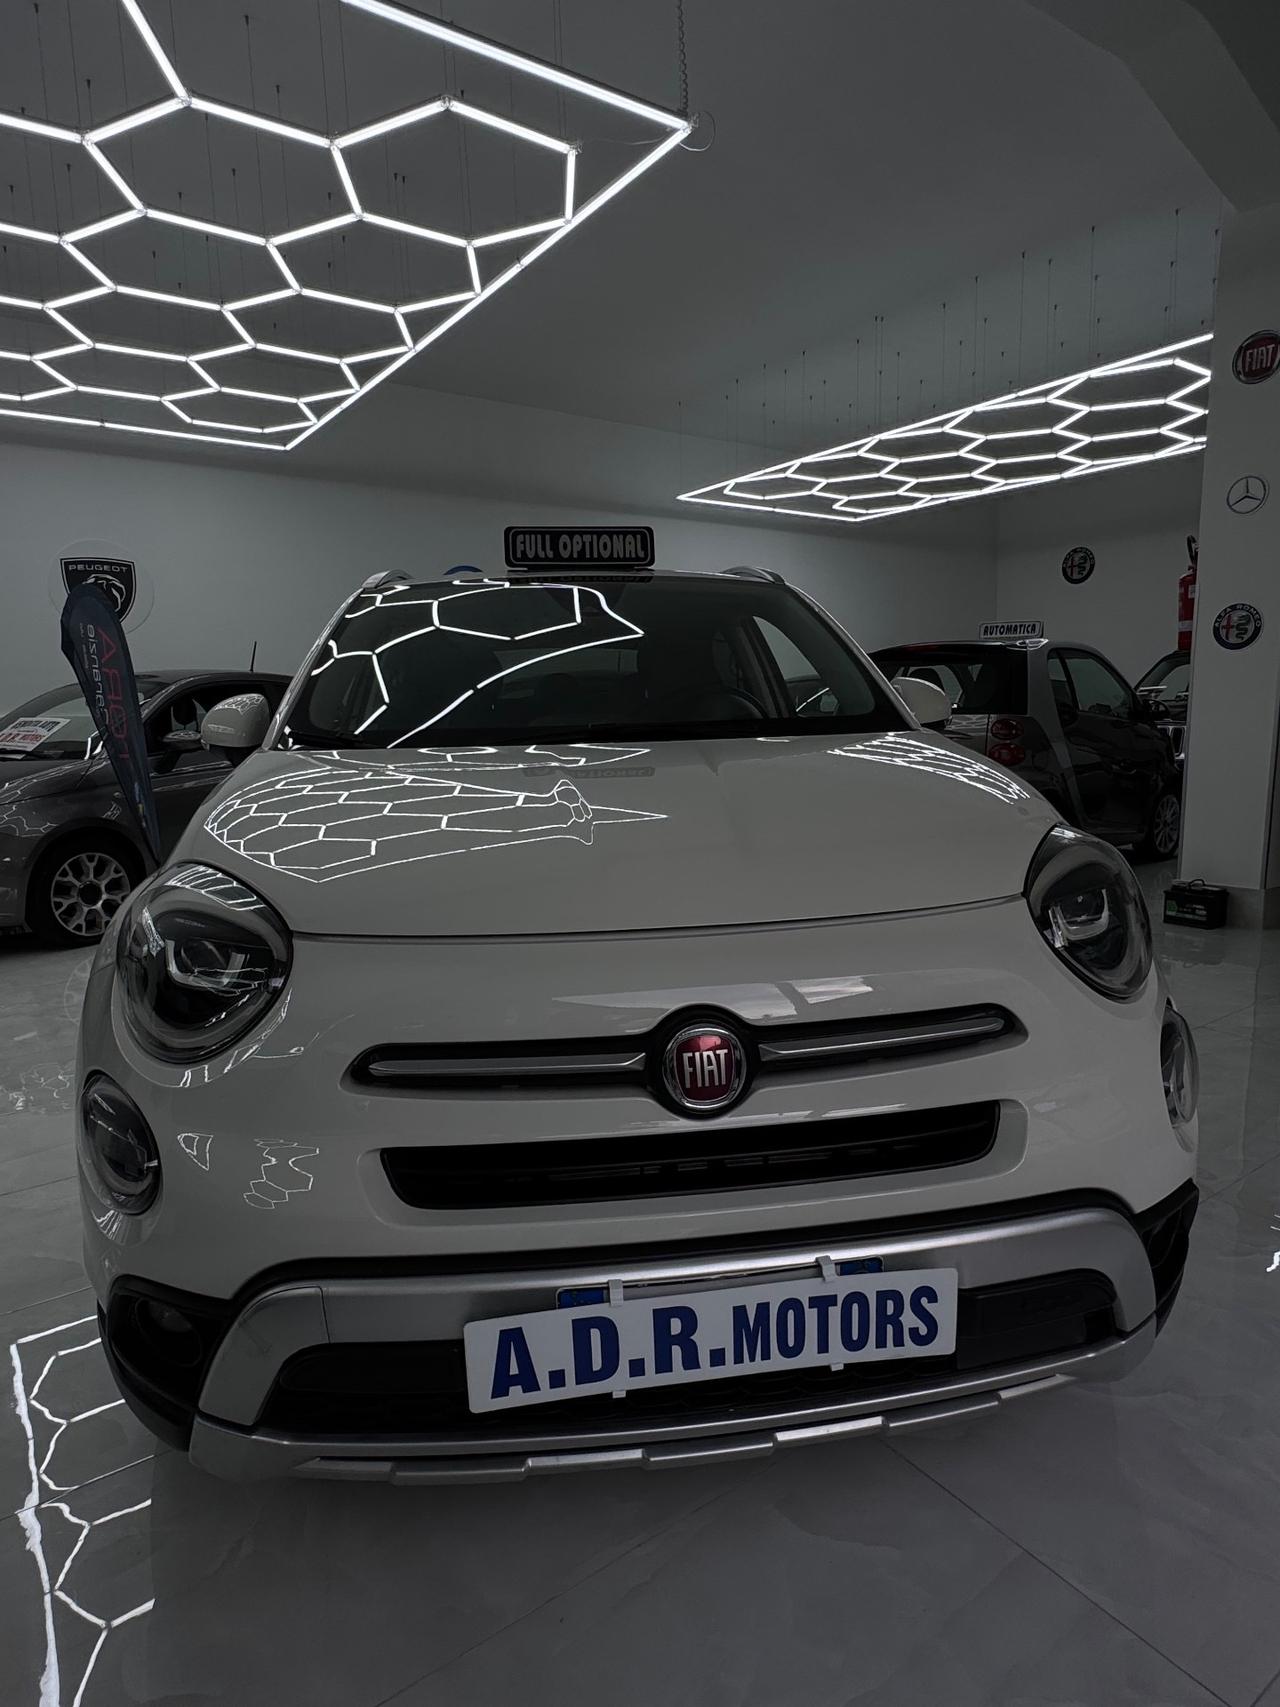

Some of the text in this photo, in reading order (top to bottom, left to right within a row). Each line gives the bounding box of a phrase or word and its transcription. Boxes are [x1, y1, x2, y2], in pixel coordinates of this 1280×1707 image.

[1245, 343, 1276, 372] FIAT
[516, 534, 645, 558] FULL OPTIONAL
[68, 563, 128, 573] PEUGEOT
[983, 623, 1037, 636] AUTOMATICA
[681, 1047, 729, 1089] FIAT
